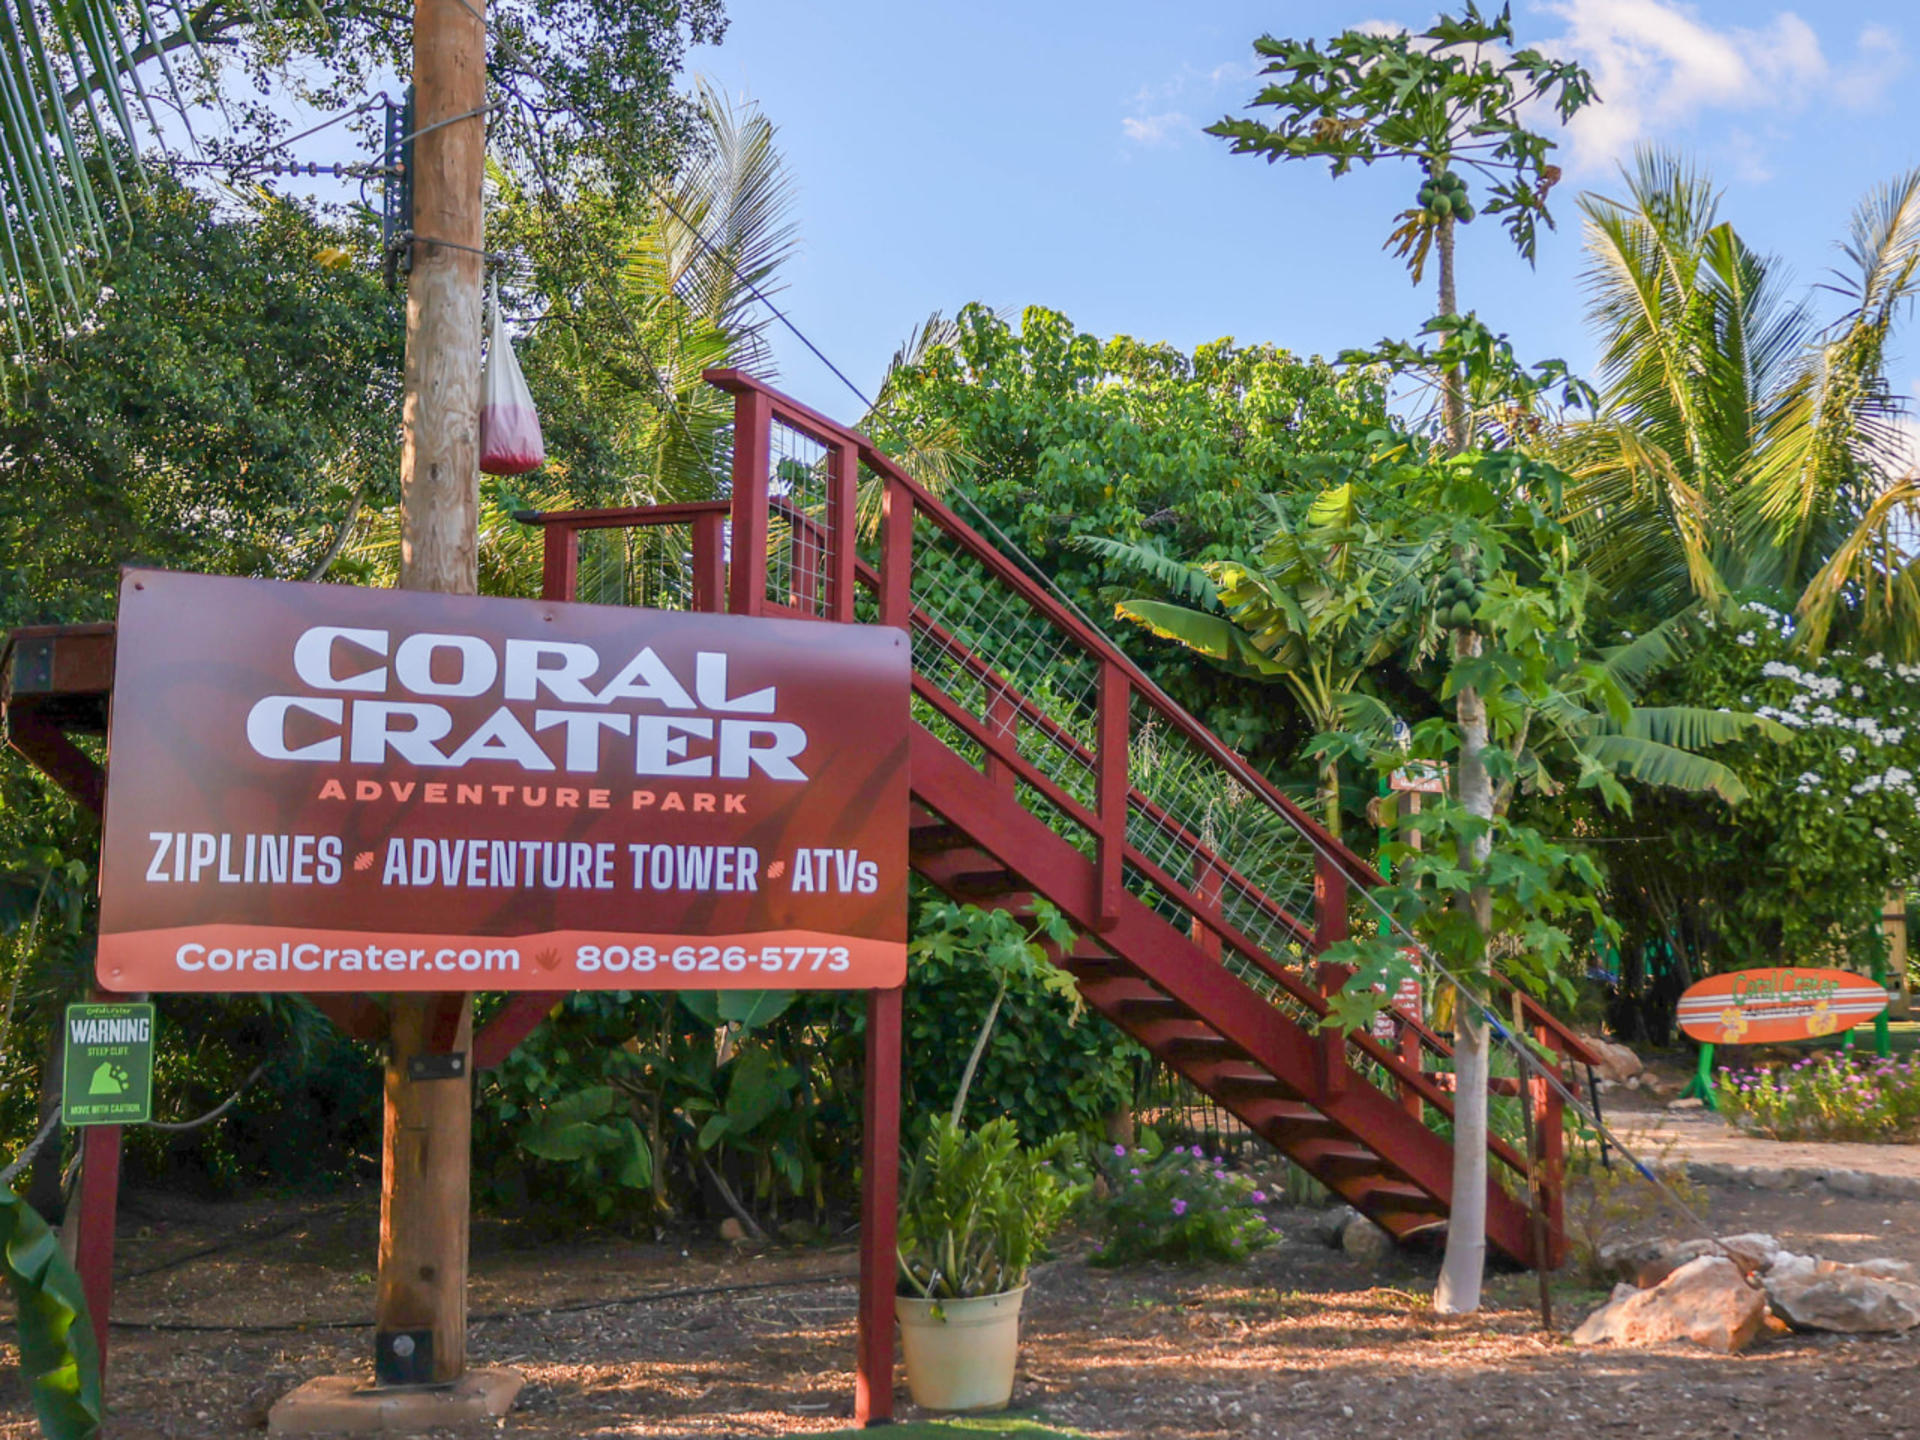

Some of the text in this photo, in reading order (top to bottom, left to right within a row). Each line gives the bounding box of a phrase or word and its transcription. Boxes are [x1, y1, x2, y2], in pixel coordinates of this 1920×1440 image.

[293, 626, 776, 714] CORAL
[246, 695, 809, 781] CRATER
[318, 779, 747, 814] ADVENTURE PARK
[145, 832, 878, 894] ZIPLINES ADVENTURE TOWER ATVs
[175, 942, 850, 974] CoralCrater.com 808-626-5773
[70, 1018, 149, 1043] WARNING
